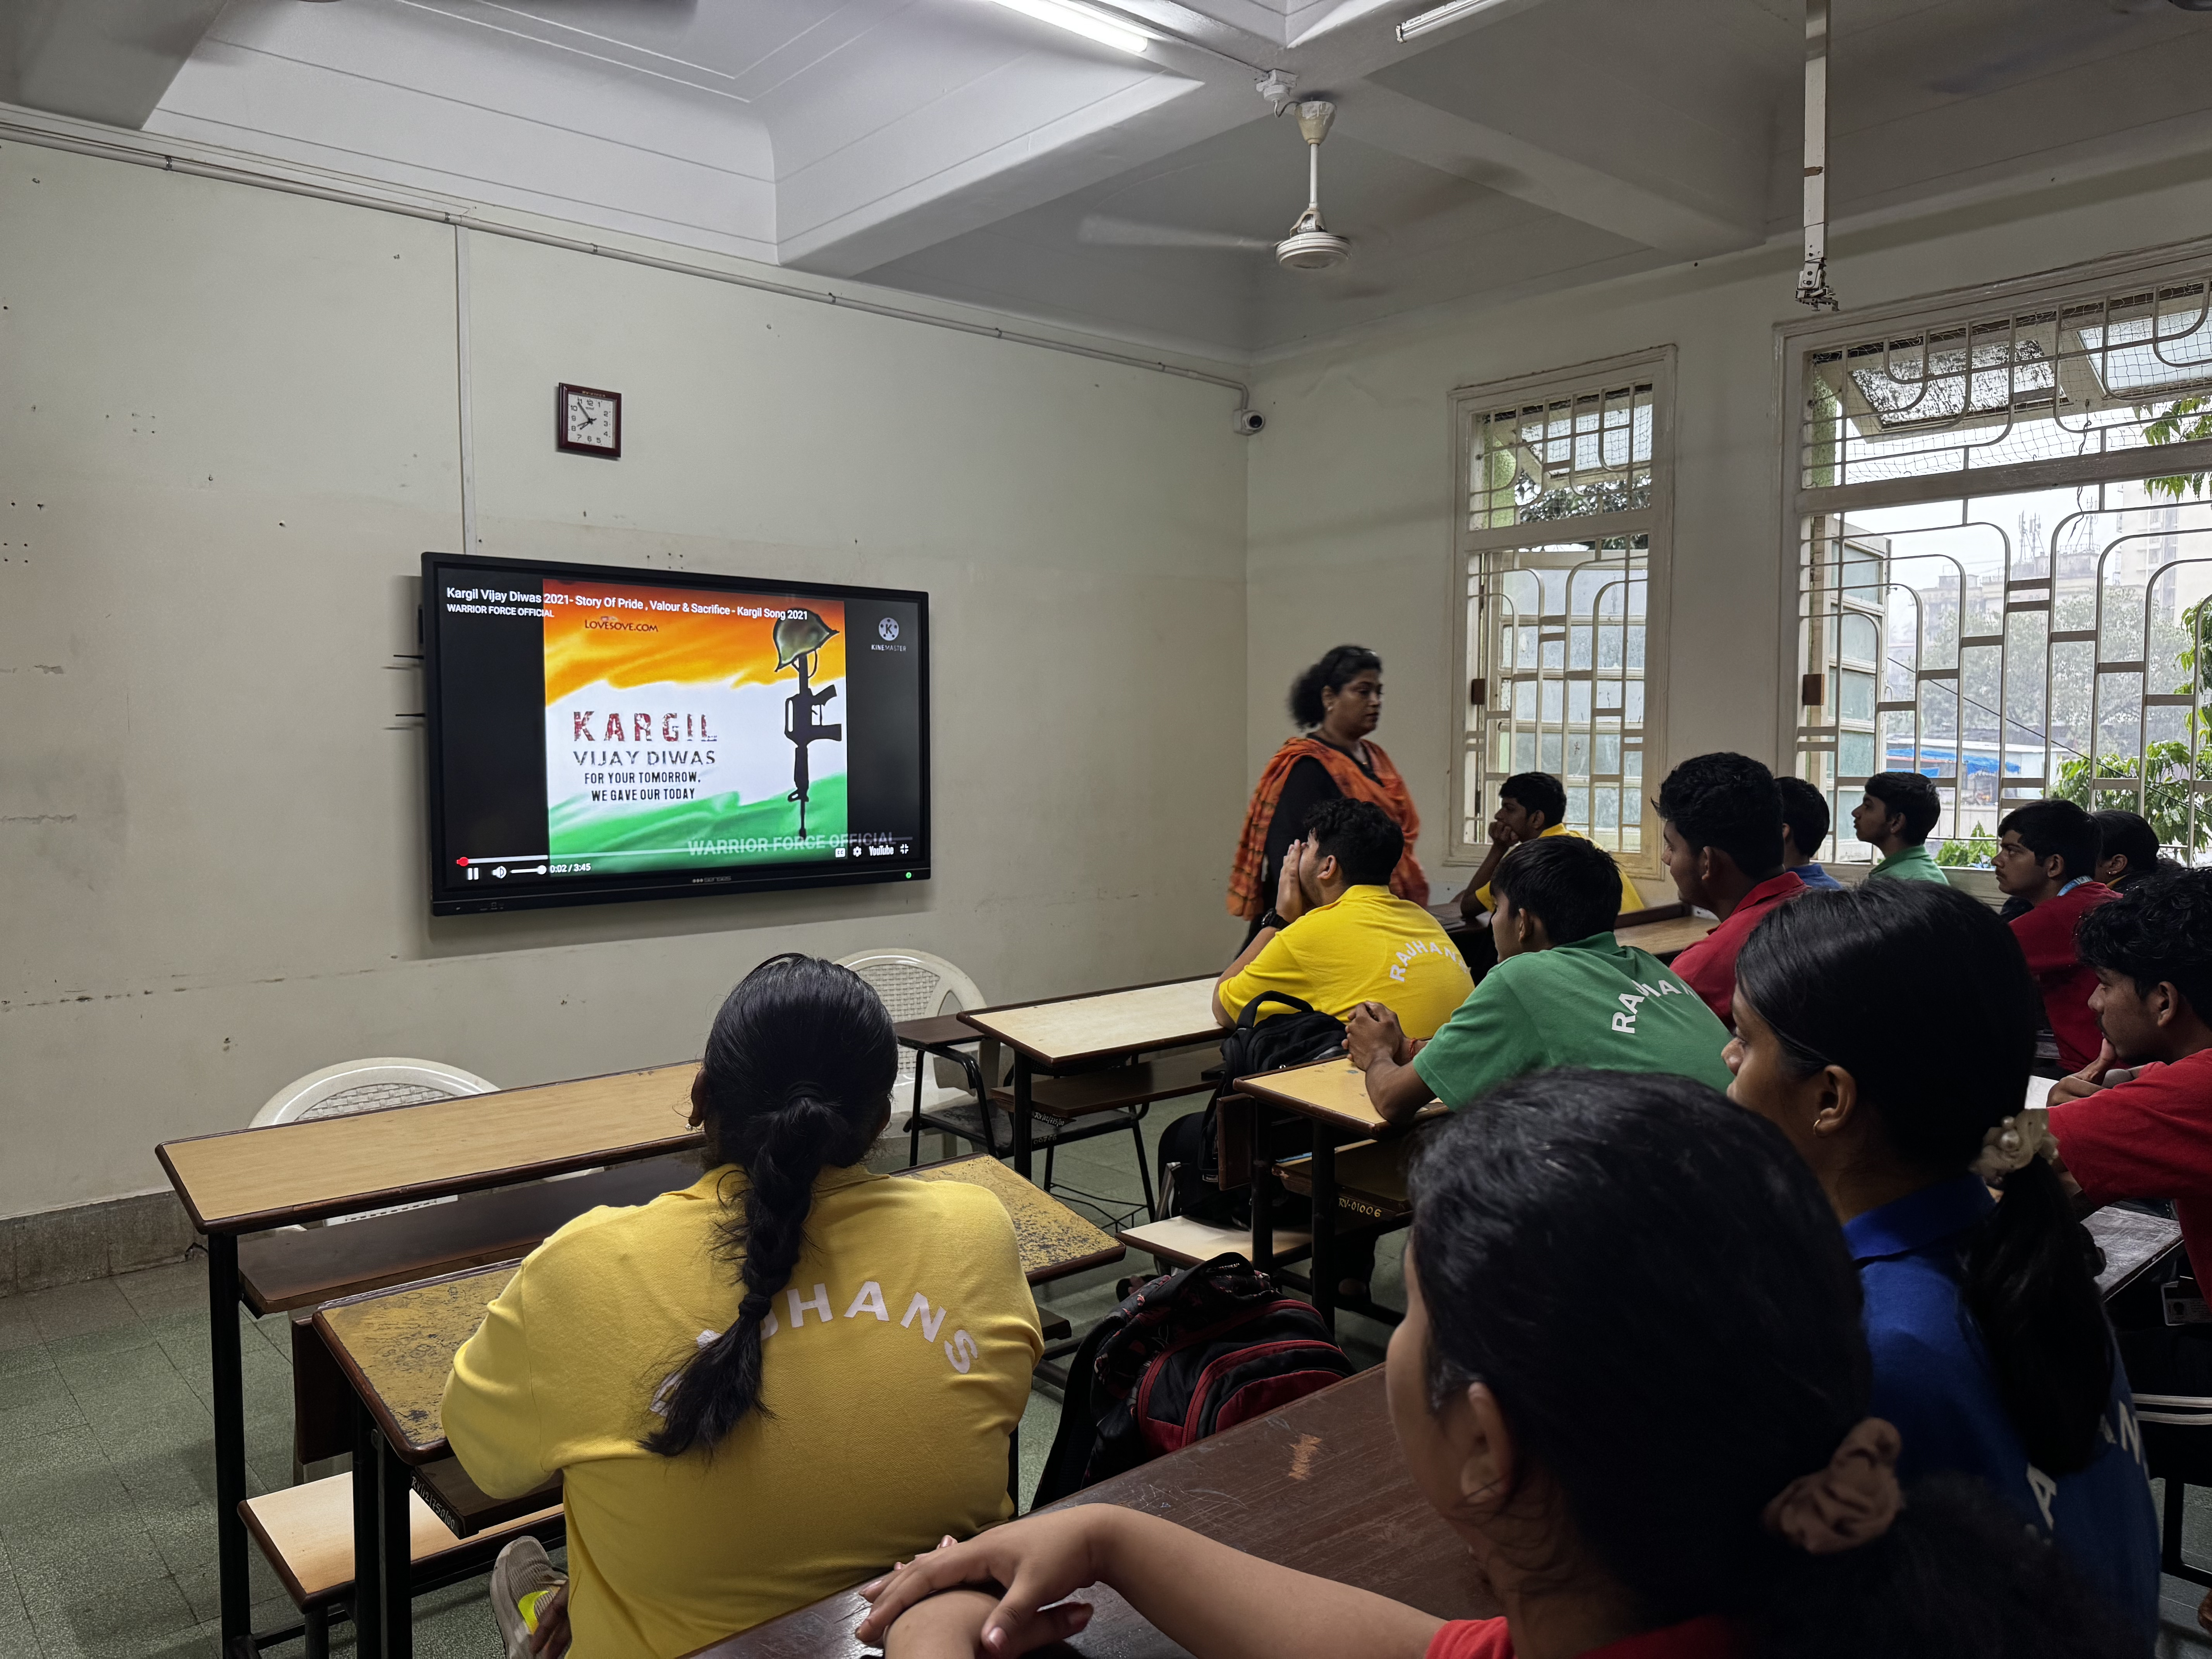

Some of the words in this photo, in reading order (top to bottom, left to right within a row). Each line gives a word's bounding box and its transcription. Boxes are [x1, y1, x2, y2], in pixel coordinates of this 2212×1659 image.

[447, 587, 478, 601] Kargil
[481, 589, 507, 603] Vijay
[510, 591, 542, 603] Diwas
[575, 595, 602, 608] Story
[604, 597, 616, 607] Of
[649, 600, 680, 611] Valour
[682, 603, 689, 612] &
[691, 603, 730, 615] Sacrifice
[737, 606, 762, 618] Kargil
[764, 608, 785, 620] Song
[787, 610, 807, 620] 2021
[447, 604, 487, 613] WARRIOR
[489, 606, 516, 615] FORCE
[518, 608, 555, 617] OFFICIAL
[585, 620, 658, 632] LOVESOVE.COM
[886, 624, 892, 634] K
[574, 711, 717, 742] KARGIL
[573, 751, 639, 766] VIJAY
[647, 750, 715, 765] DIWAS
[585, 773, 604, 784] FOR
[608, 773, 635, 783] YOUR
[639, 771, 701, 783] TOMORROW.
[591, 790, 607, 801] WE
[611, 789, 637, 801] GAVE
[640, 789, 659, 800] OUR
[663, 788, 695, 799] TODAY
[688, 837, 768, 856] WARRIOR
[773, 835, 825, 852] FORCE
[829, 832, 896, 847] OFFICIAL
[869, 845, 894, 856] YouTube
[550, 864, 567, 873] 0:02
[574, 863, 591, 872] 3:45
[649, 1281, 978, 1417] HANS
